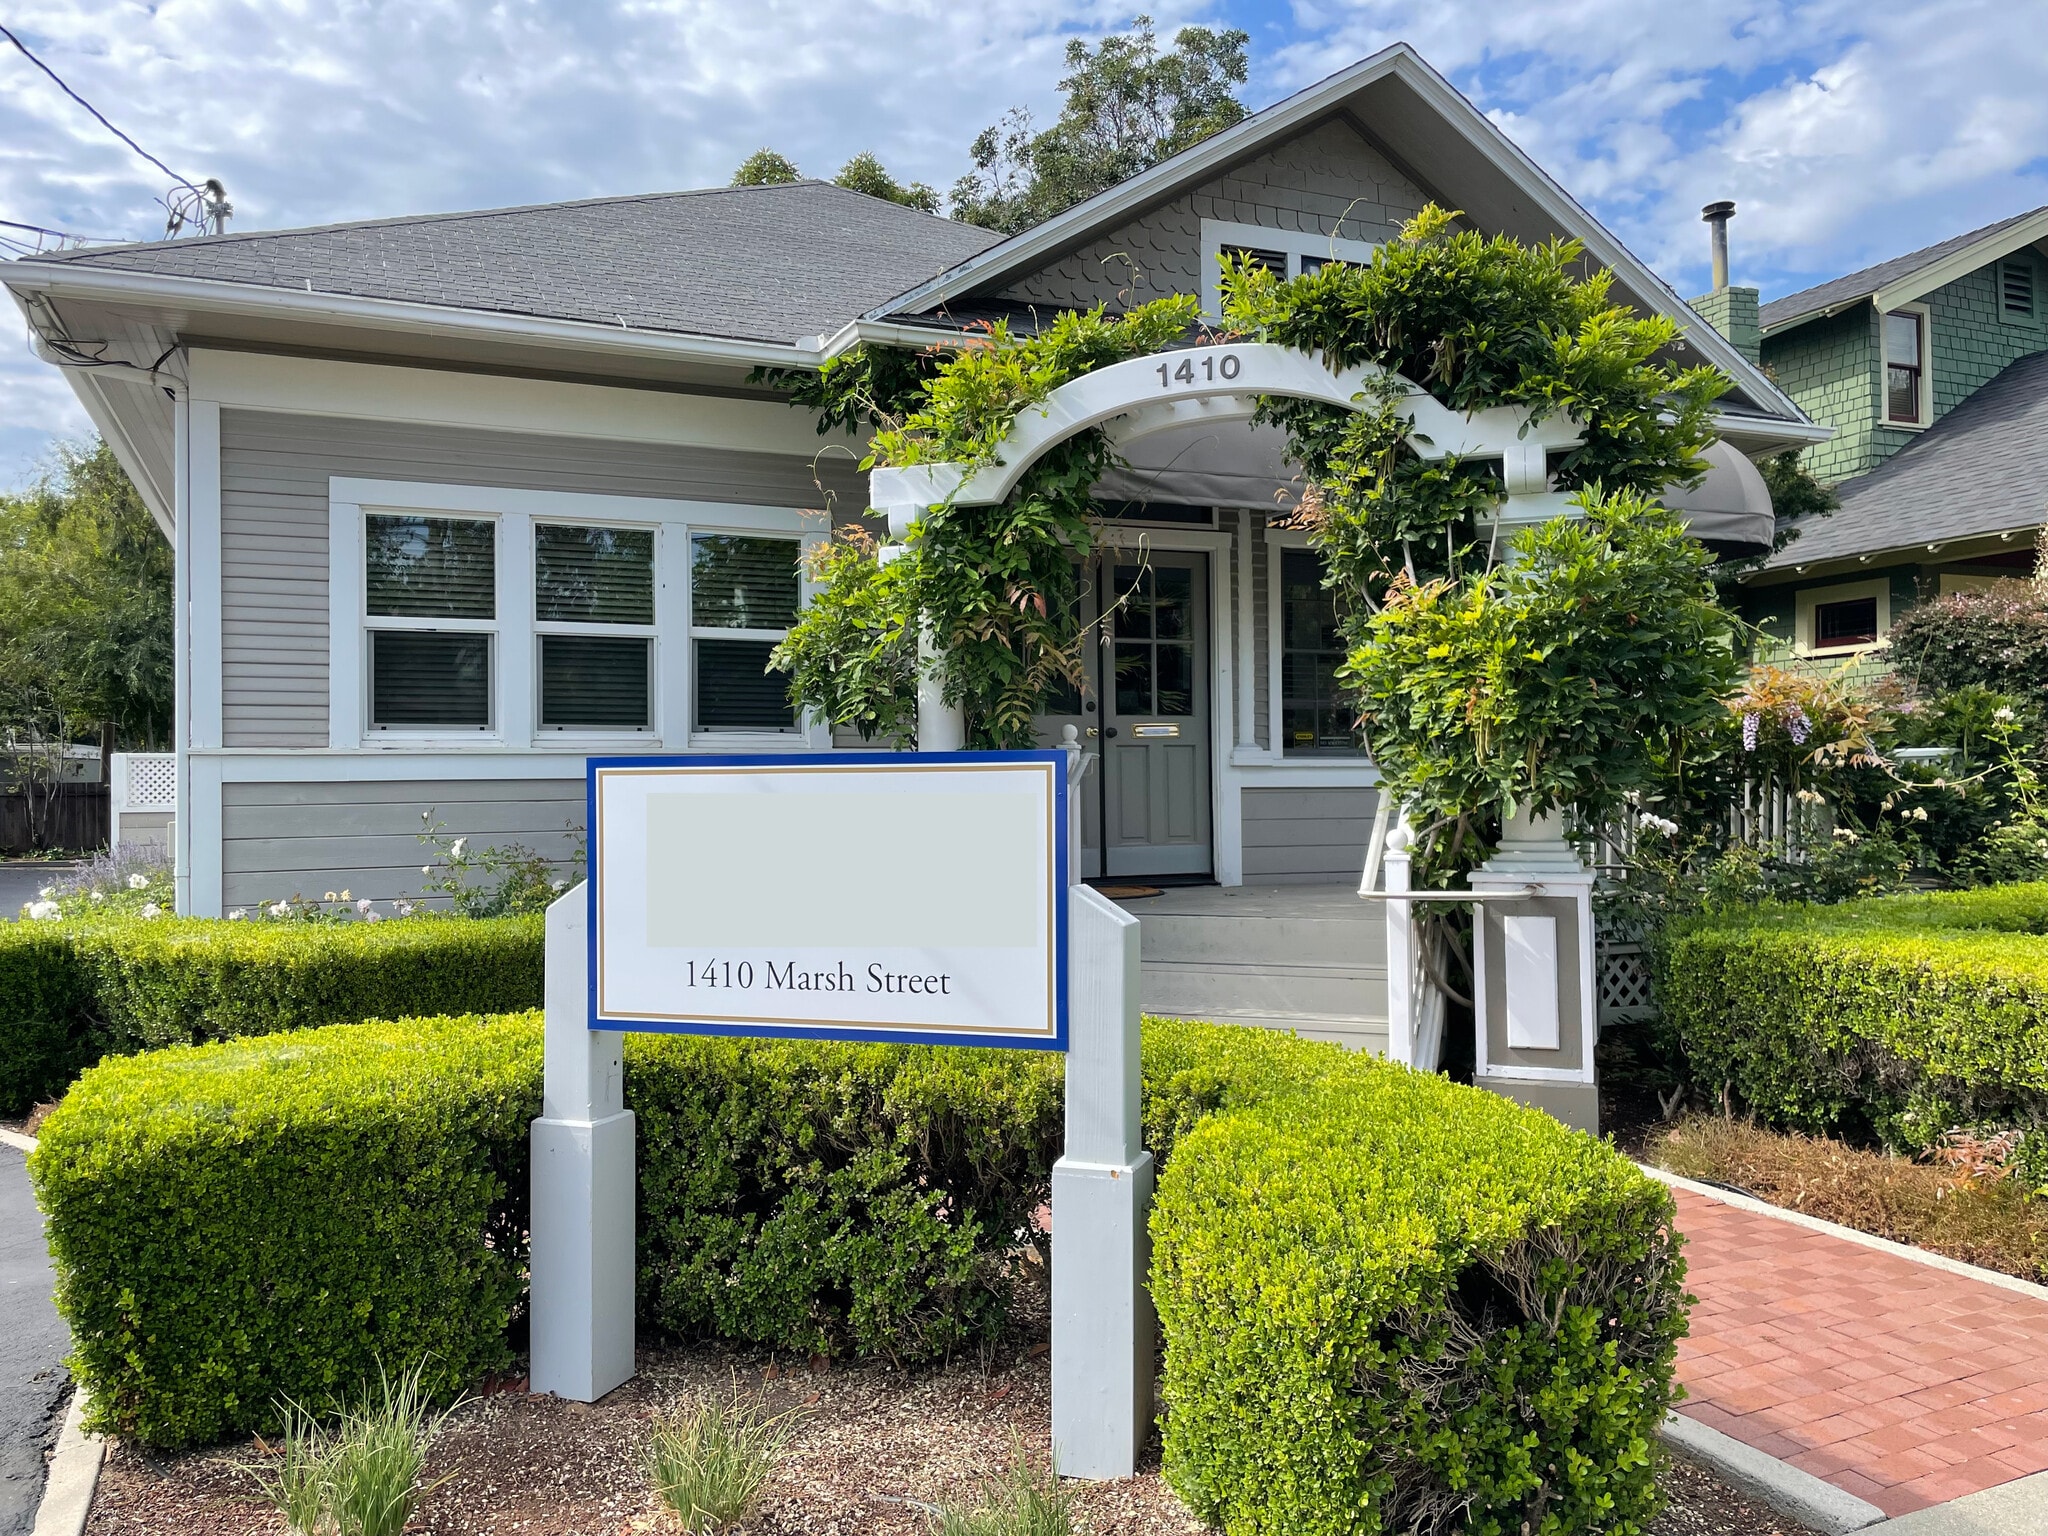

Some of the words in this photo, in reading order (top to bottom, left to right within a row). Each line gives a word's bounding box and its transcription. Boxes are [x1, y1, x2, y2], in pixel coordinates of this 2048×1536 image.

[1156, 354, 1241, 388] 1410
[686, 957, 754, 989] 1410
[764, 960, 856, 992] Marsh
[866, 962, 951, 995] Street
